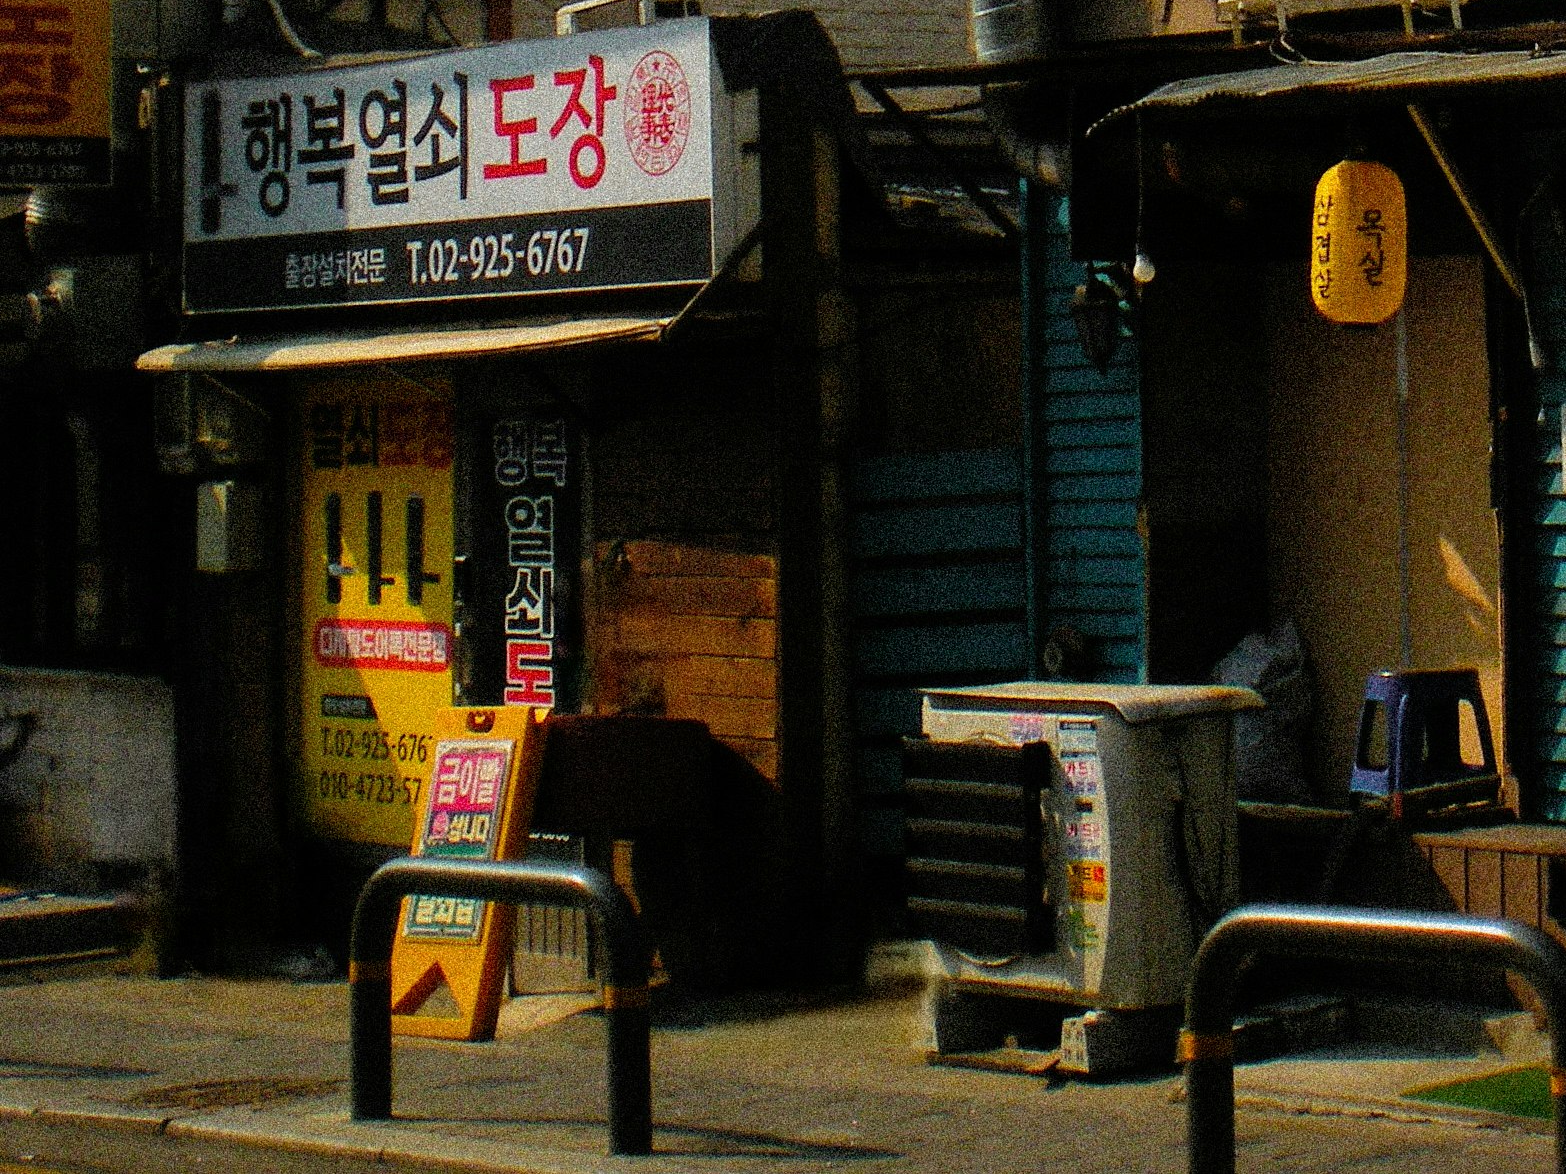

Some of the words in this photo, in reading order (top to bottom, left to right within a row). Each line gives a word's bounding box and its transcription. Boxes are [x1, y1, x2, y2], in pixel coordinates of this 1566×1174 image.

[284, 247, 386, 289] 출장설치전문
[404, 226, 590, 286] T.02-925-6767
[320, 726, 433, 763] T.02-925-676
[319, 770, 422, 806] 010-4723-57
